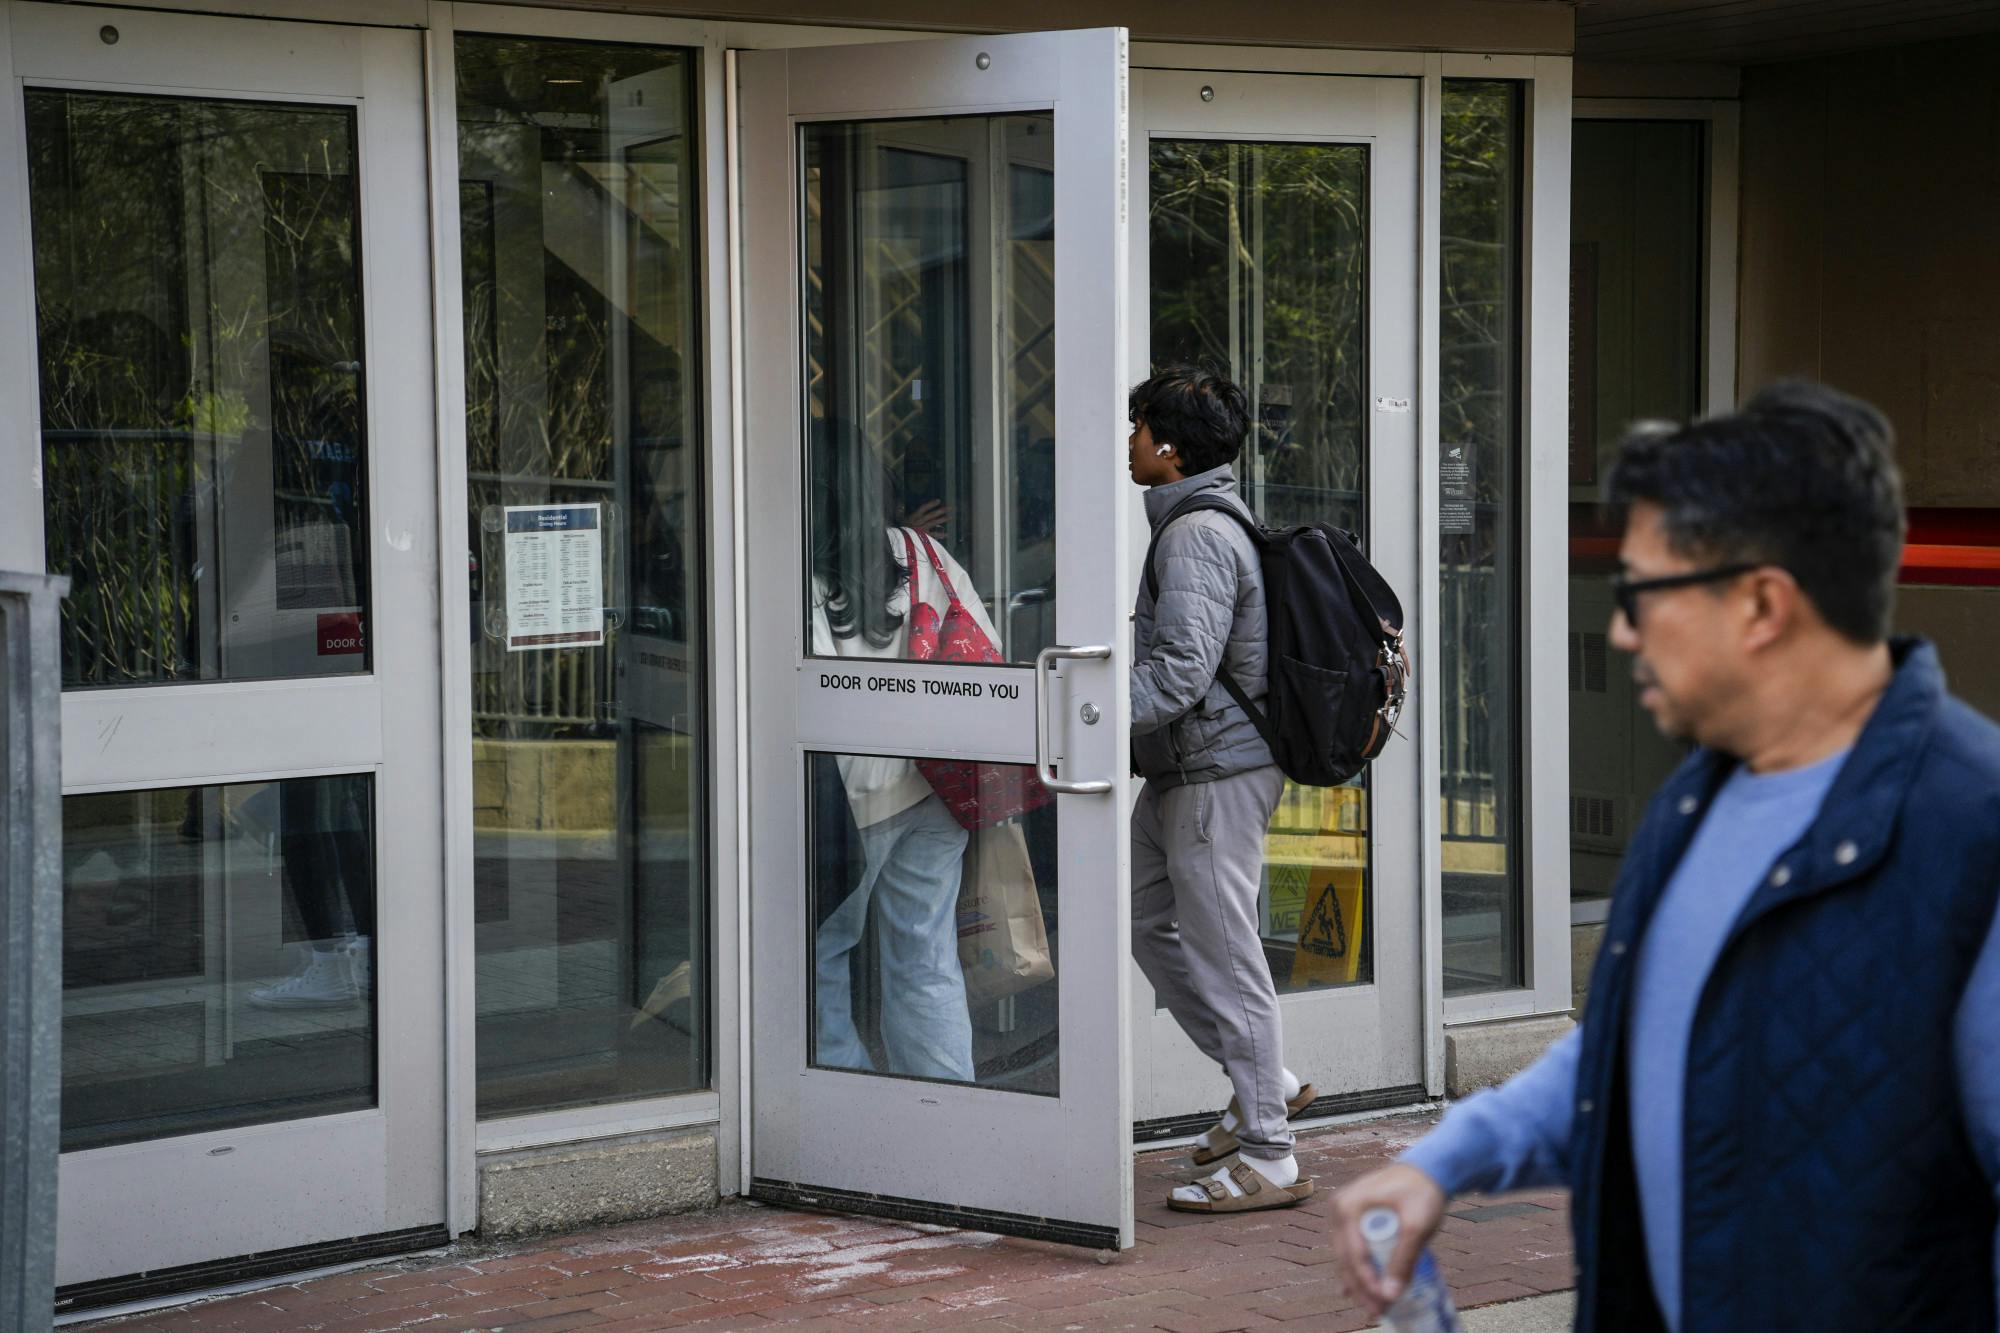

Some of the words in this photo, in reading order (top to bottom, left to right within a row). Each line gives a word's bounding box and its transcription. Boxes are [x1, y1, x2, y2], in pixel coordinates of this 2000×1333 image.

[326, 638, 356, 648] DOOR
[820, 674, 861, 690] DOOR
[867, 676, 916, 694] OPENS
[922, 680, 982, 697] TOWARD
[989, 684, 1019, 699] YOU
